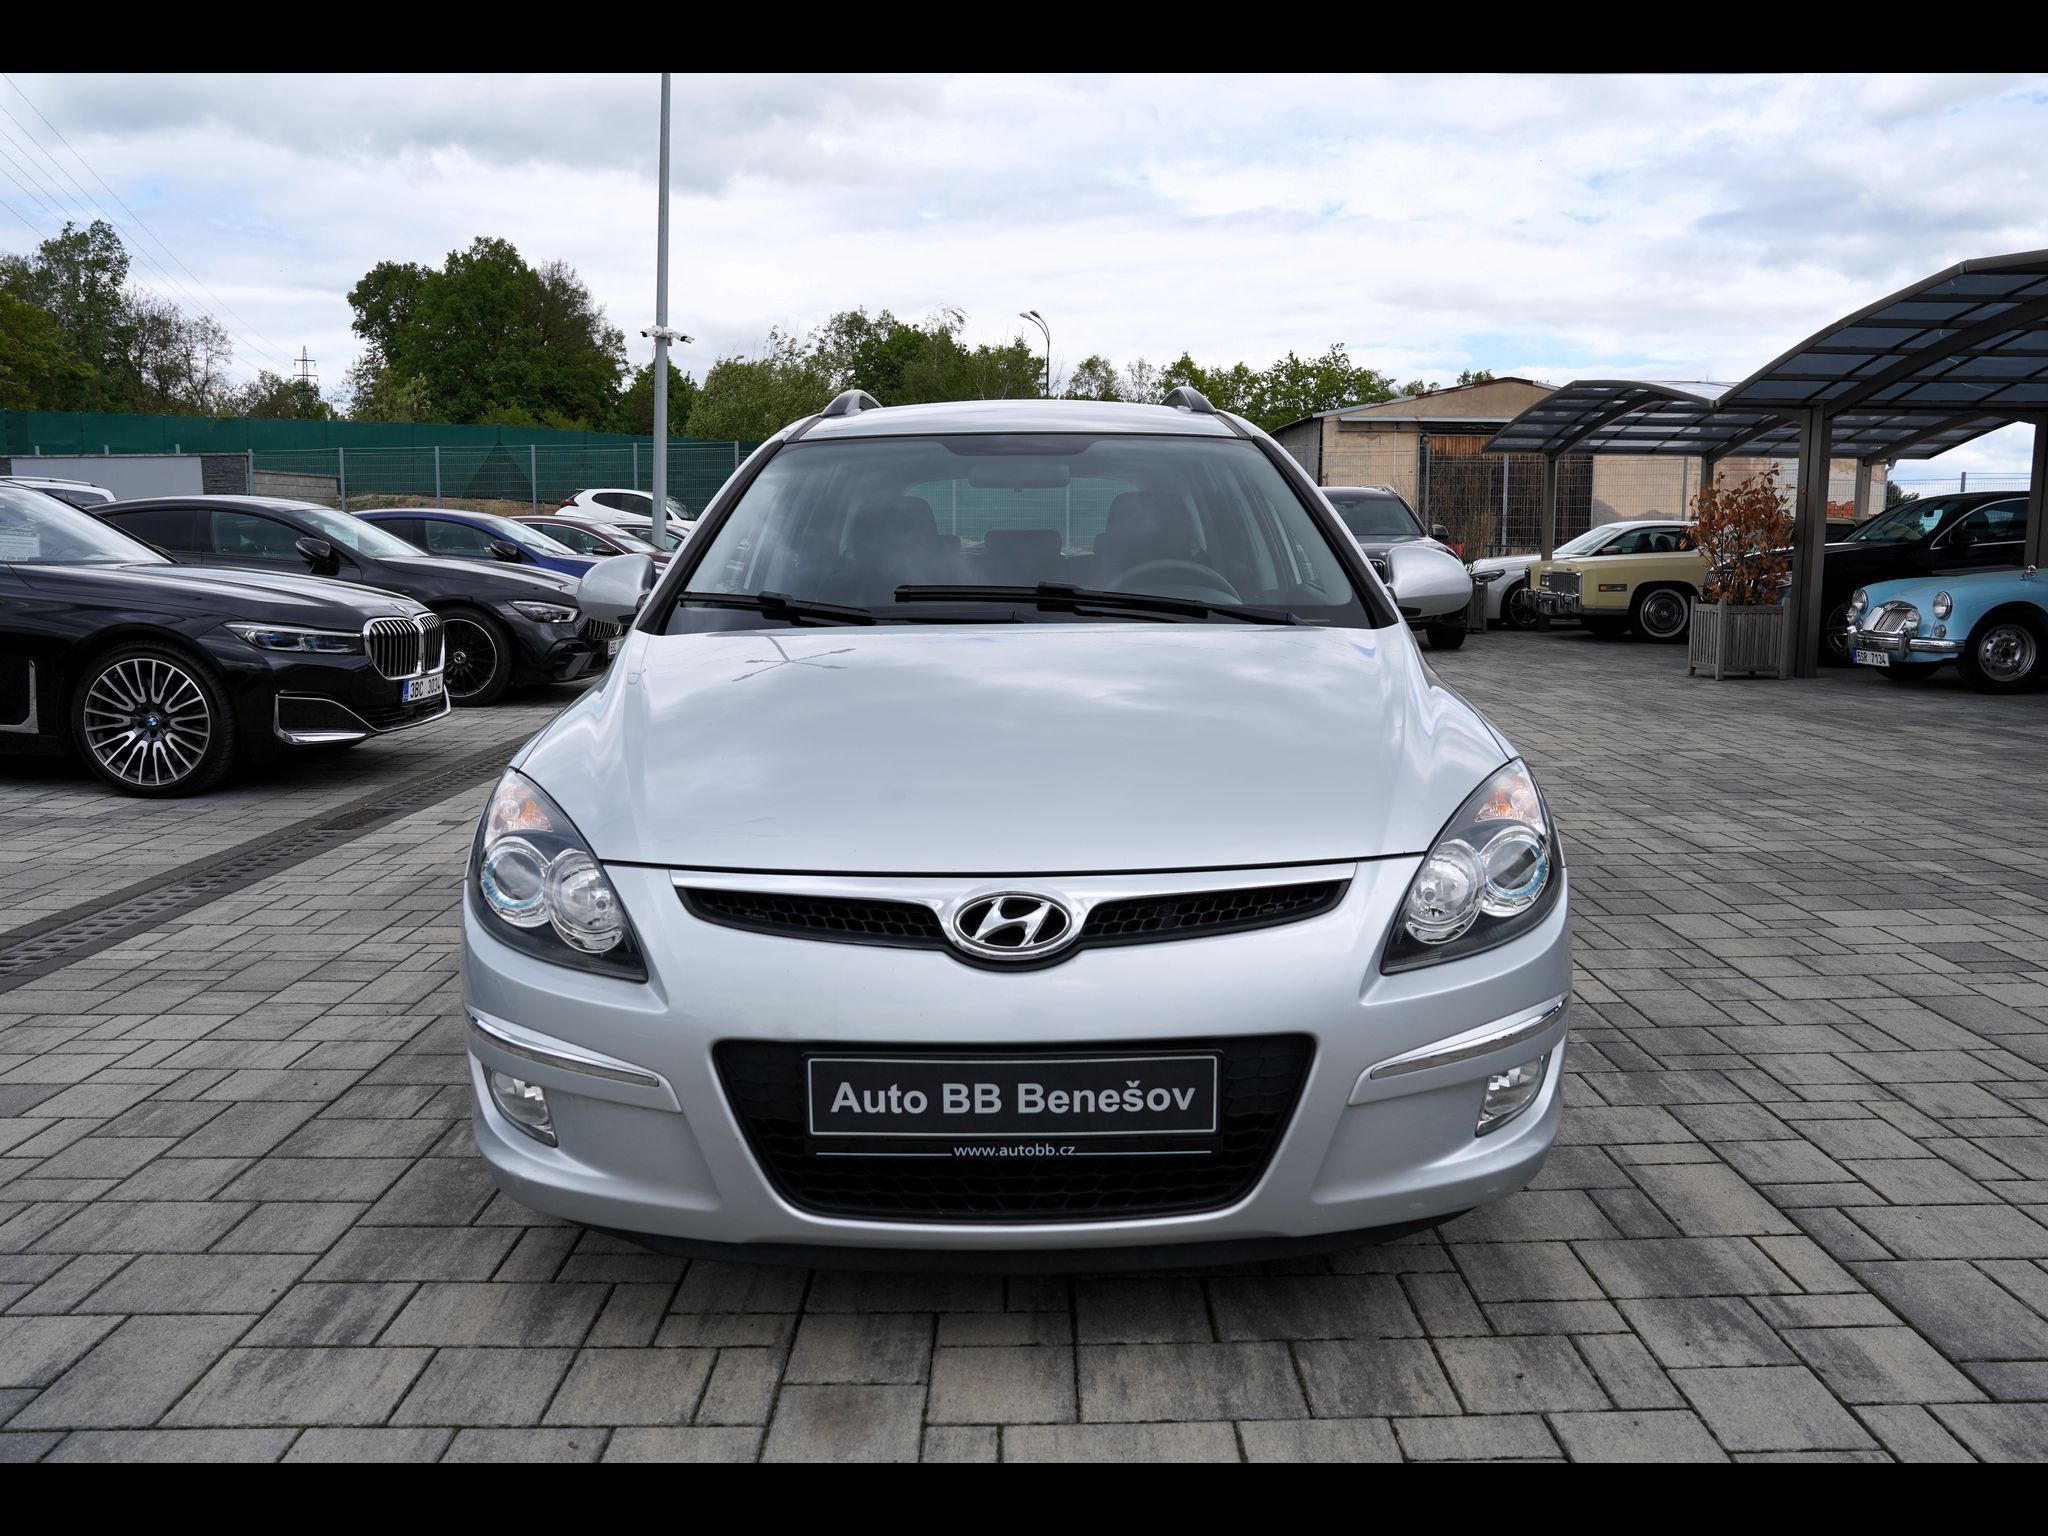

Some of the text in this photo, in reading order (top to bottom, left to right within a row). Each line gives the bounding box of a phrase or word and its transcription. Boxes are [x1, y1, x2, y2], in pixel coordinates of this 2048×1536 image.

[410, 681, 424, 698] 3BC
[830, 1080, 1196, 1114] Auto BB Benešov
[953, 1143, 1076, 1157] www.autobb.cz
